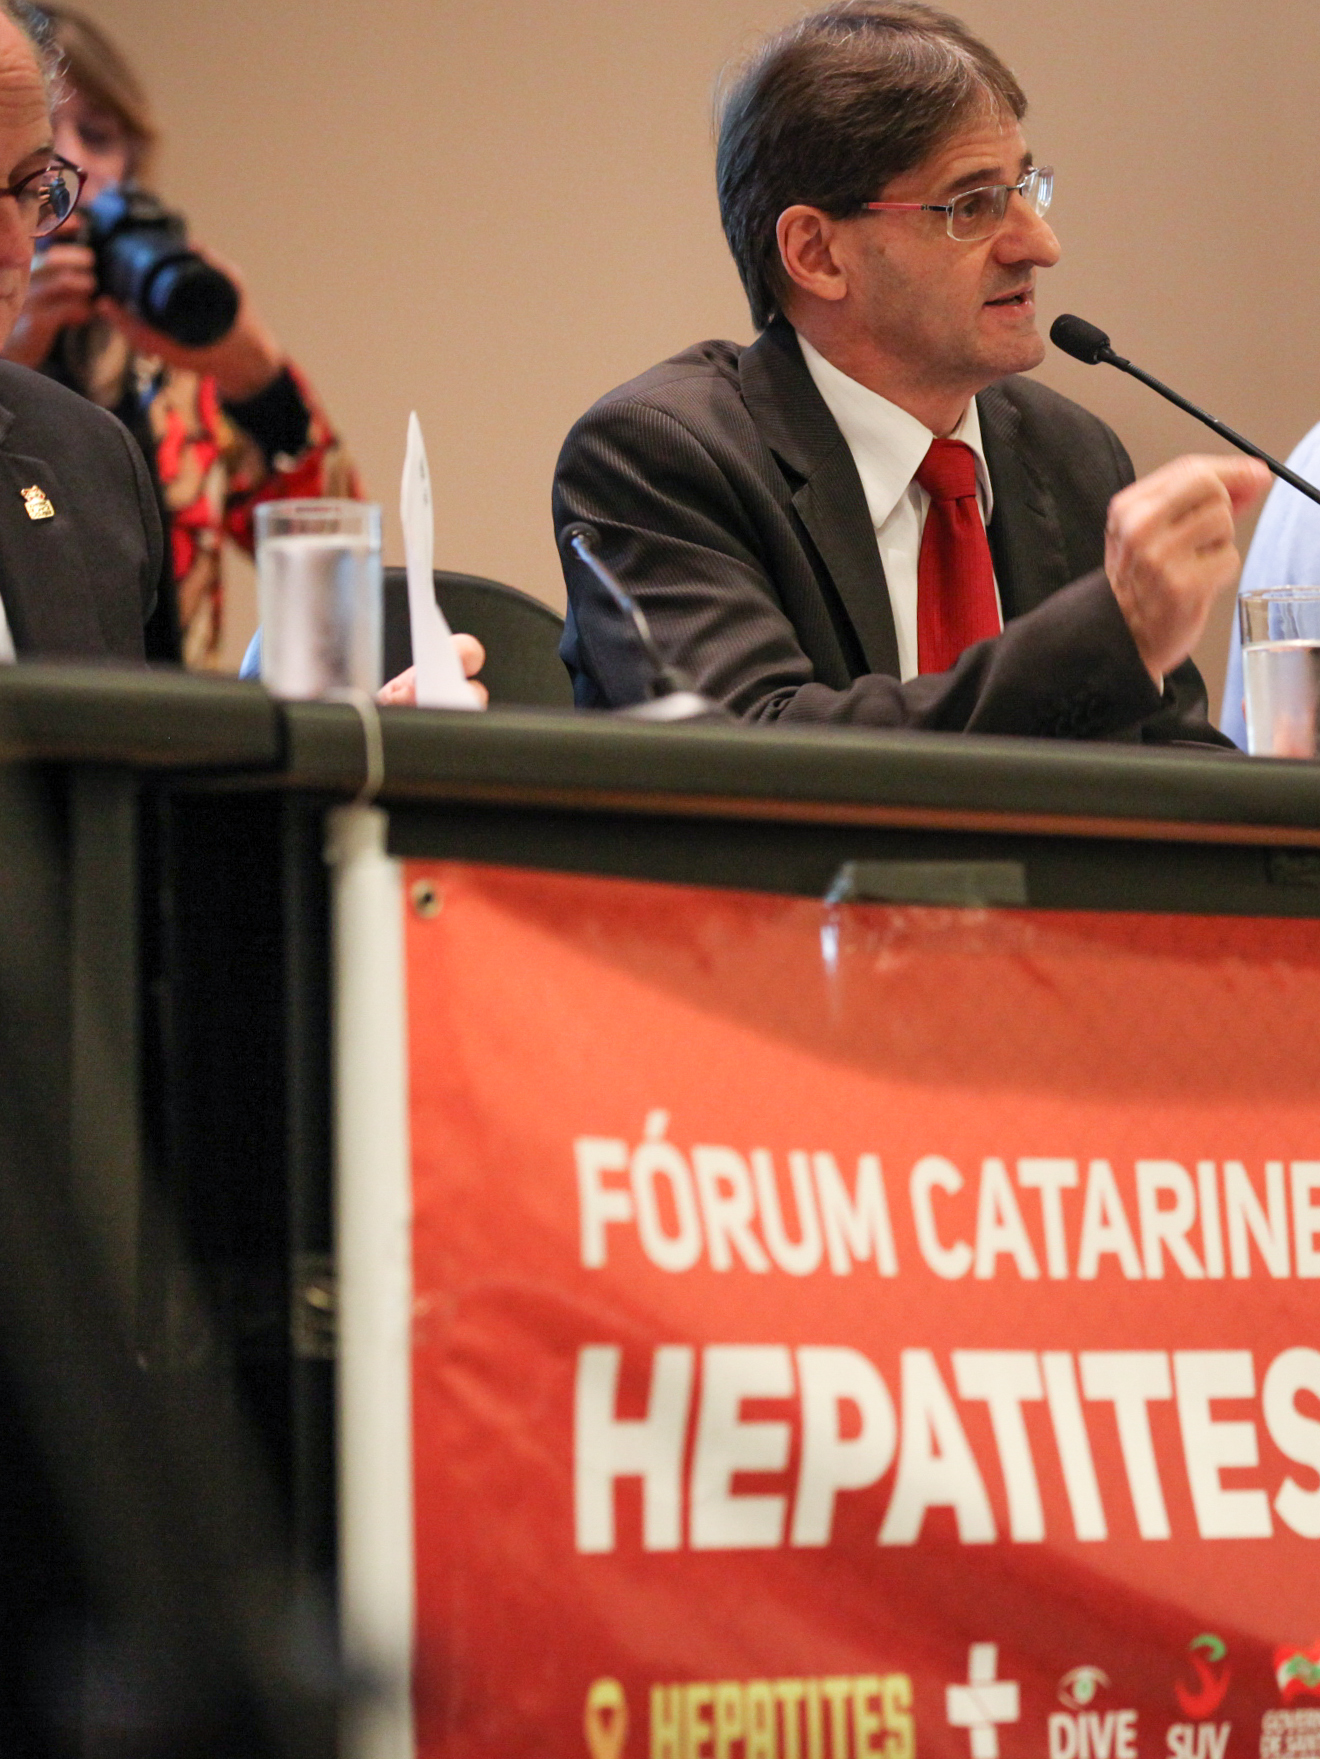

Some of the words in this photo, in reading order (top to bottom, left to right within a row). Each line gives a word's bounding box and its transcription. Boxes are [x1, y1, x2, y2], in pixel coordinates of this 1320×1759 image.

[574, 1109, 899, 1277] FÓRUM
[650, 1673, 915, 1759] HEPATITES
[1048, 1709, 1138, 1759] DIVE
